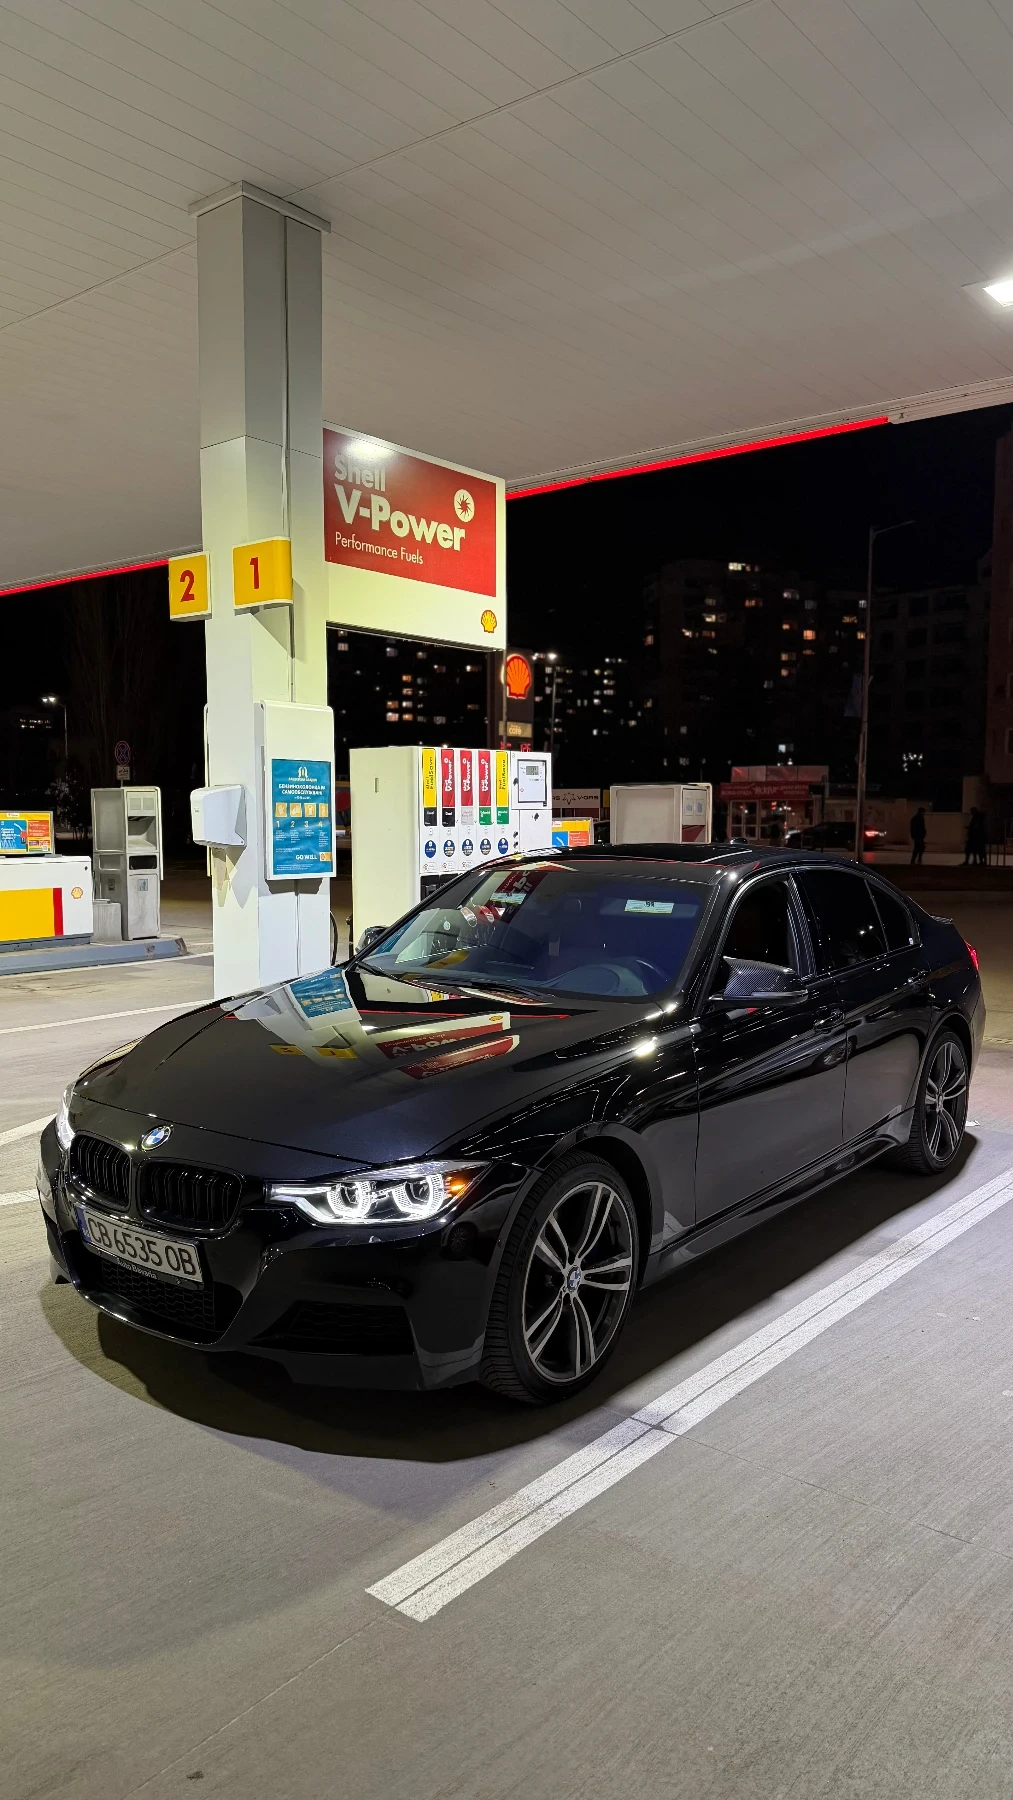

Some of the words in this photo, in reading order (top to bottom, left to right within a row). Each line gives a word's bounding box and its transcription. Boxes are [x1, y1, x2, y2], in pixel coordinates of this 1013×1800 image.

[334, 453, 386, 492] Shell
[334, 483, 466, 552] V-Power
[335, 532, 398, 559] Performance
[401, 547, 424, 565] Fuels
[180, 570, 195, 602] 2
[249, 557, 260, 589] 1
[87, 1217, 112, 1249] CB
[114, 1229, 163, 1267] 6535
